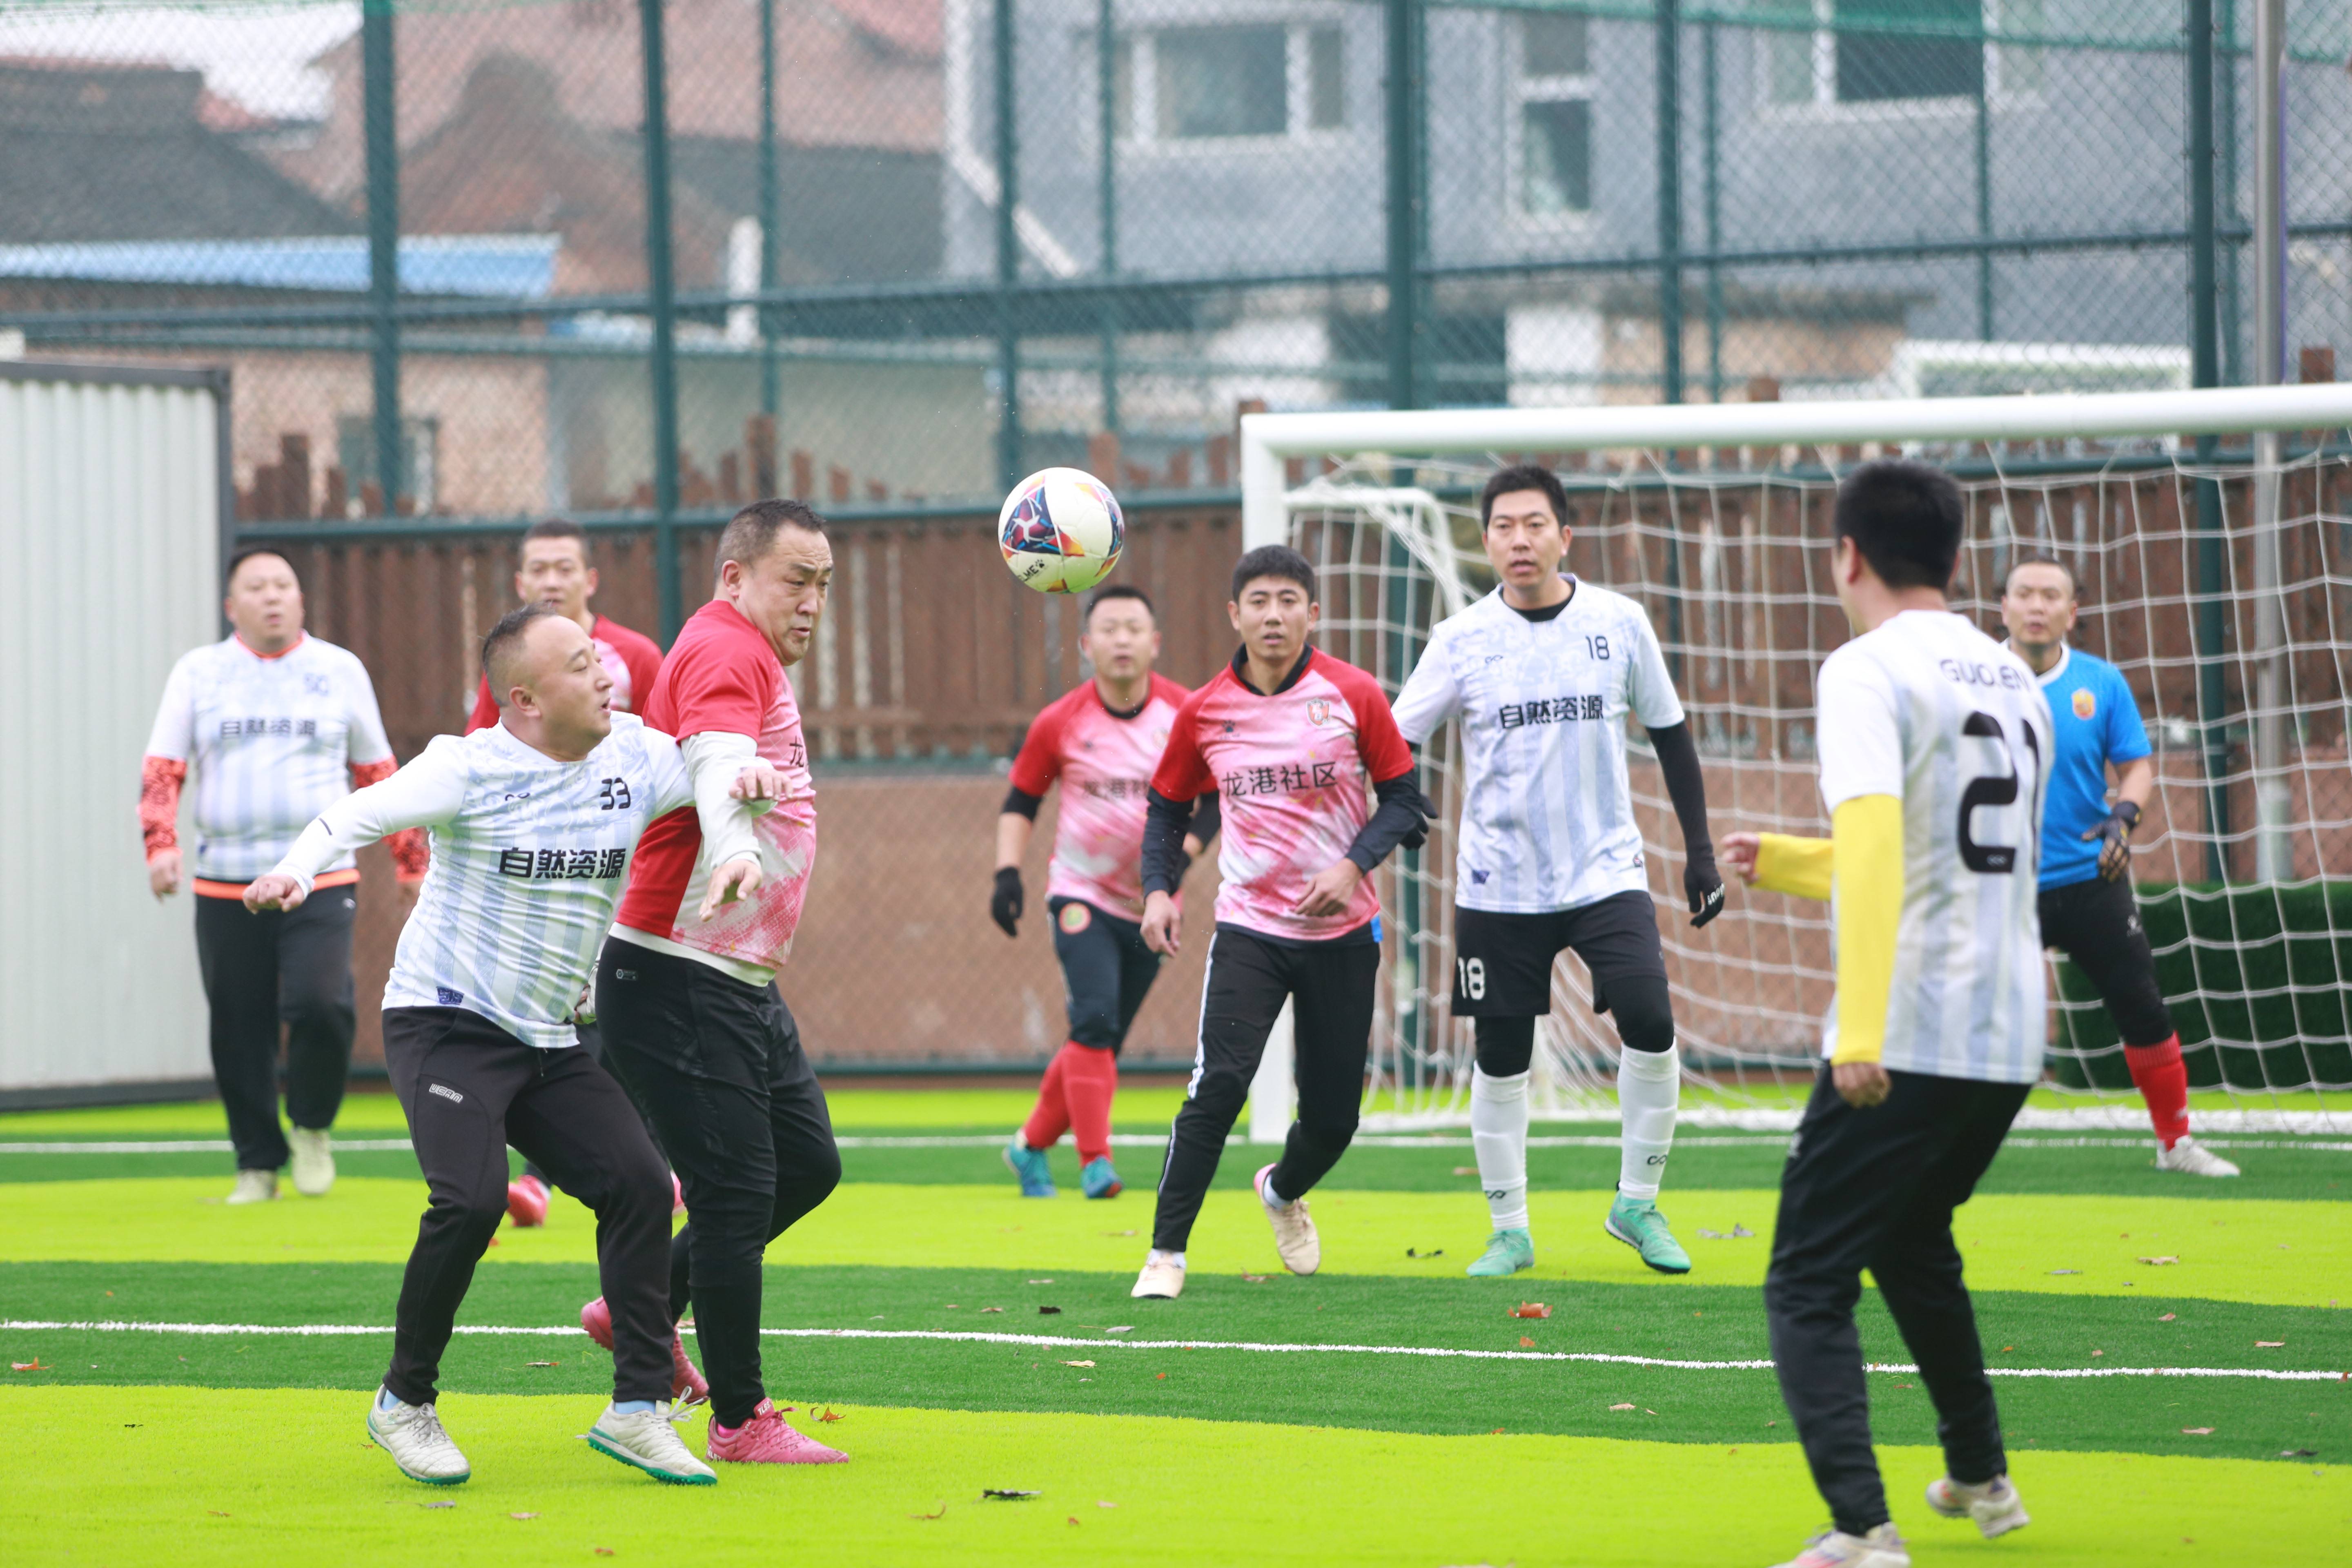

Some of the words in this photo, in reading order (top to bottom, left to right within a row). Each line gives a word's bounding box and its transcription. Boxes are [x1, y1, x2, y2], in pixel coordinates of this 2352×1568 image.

[1585, 635, 1610, 660] 18
[1499, 695, 1604, 728] 自然资源
[600, 777, 631, 811] 33
[1222, 762, 1338, 797] 龙港社区
[1957, 710, 2041, 878] 21
[499, 847, 626, 878] 自然资源
[1457, 957, 1484, 1000] 18
